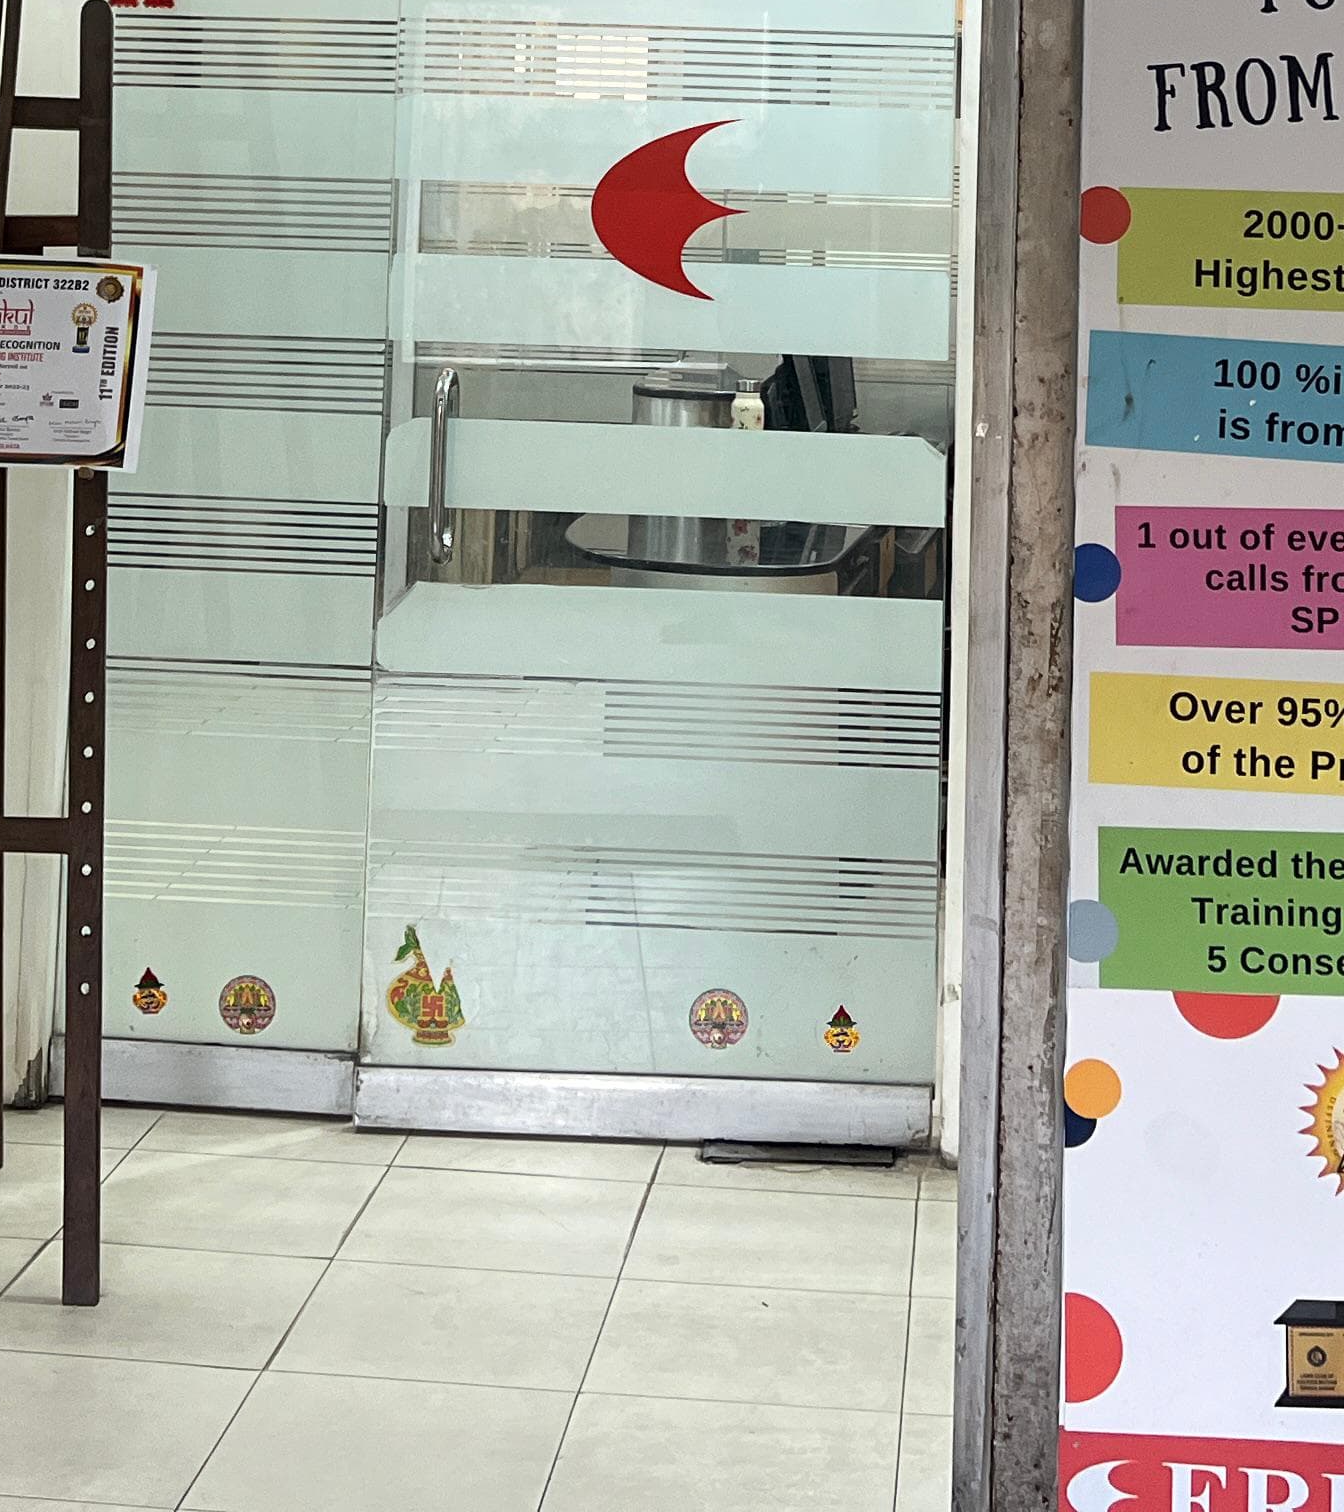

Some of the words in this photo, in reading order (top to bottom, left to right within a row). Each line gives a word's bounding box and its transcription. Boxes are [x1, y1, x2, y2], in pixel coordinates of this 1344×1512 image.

[1147, 52, 1339, 132] FROM
[53, 279, 89, 291] 322B2
[100, 326, 119, 376] EDITION
[1214, 359, 1281, 389] 100
[1218, 409, 1250, 440] is
[1137, 522, 1156, 548] 1
[1169, 523, 1227, 550] out
[1239, 522, 1275, 551] of
[1205, 564, 1289, 592] calls
[1290, 606, 1340, 634] SP
[1169, 692, 1263, 726] Over
[1181, 745, 1220, 775] of
[1233, 748, 1296, 779] the
[1119, 847, 1279, 879] Awarded
[1191, 897, 1343, 935] Training
[1207, 946, 1227, 974] 5
